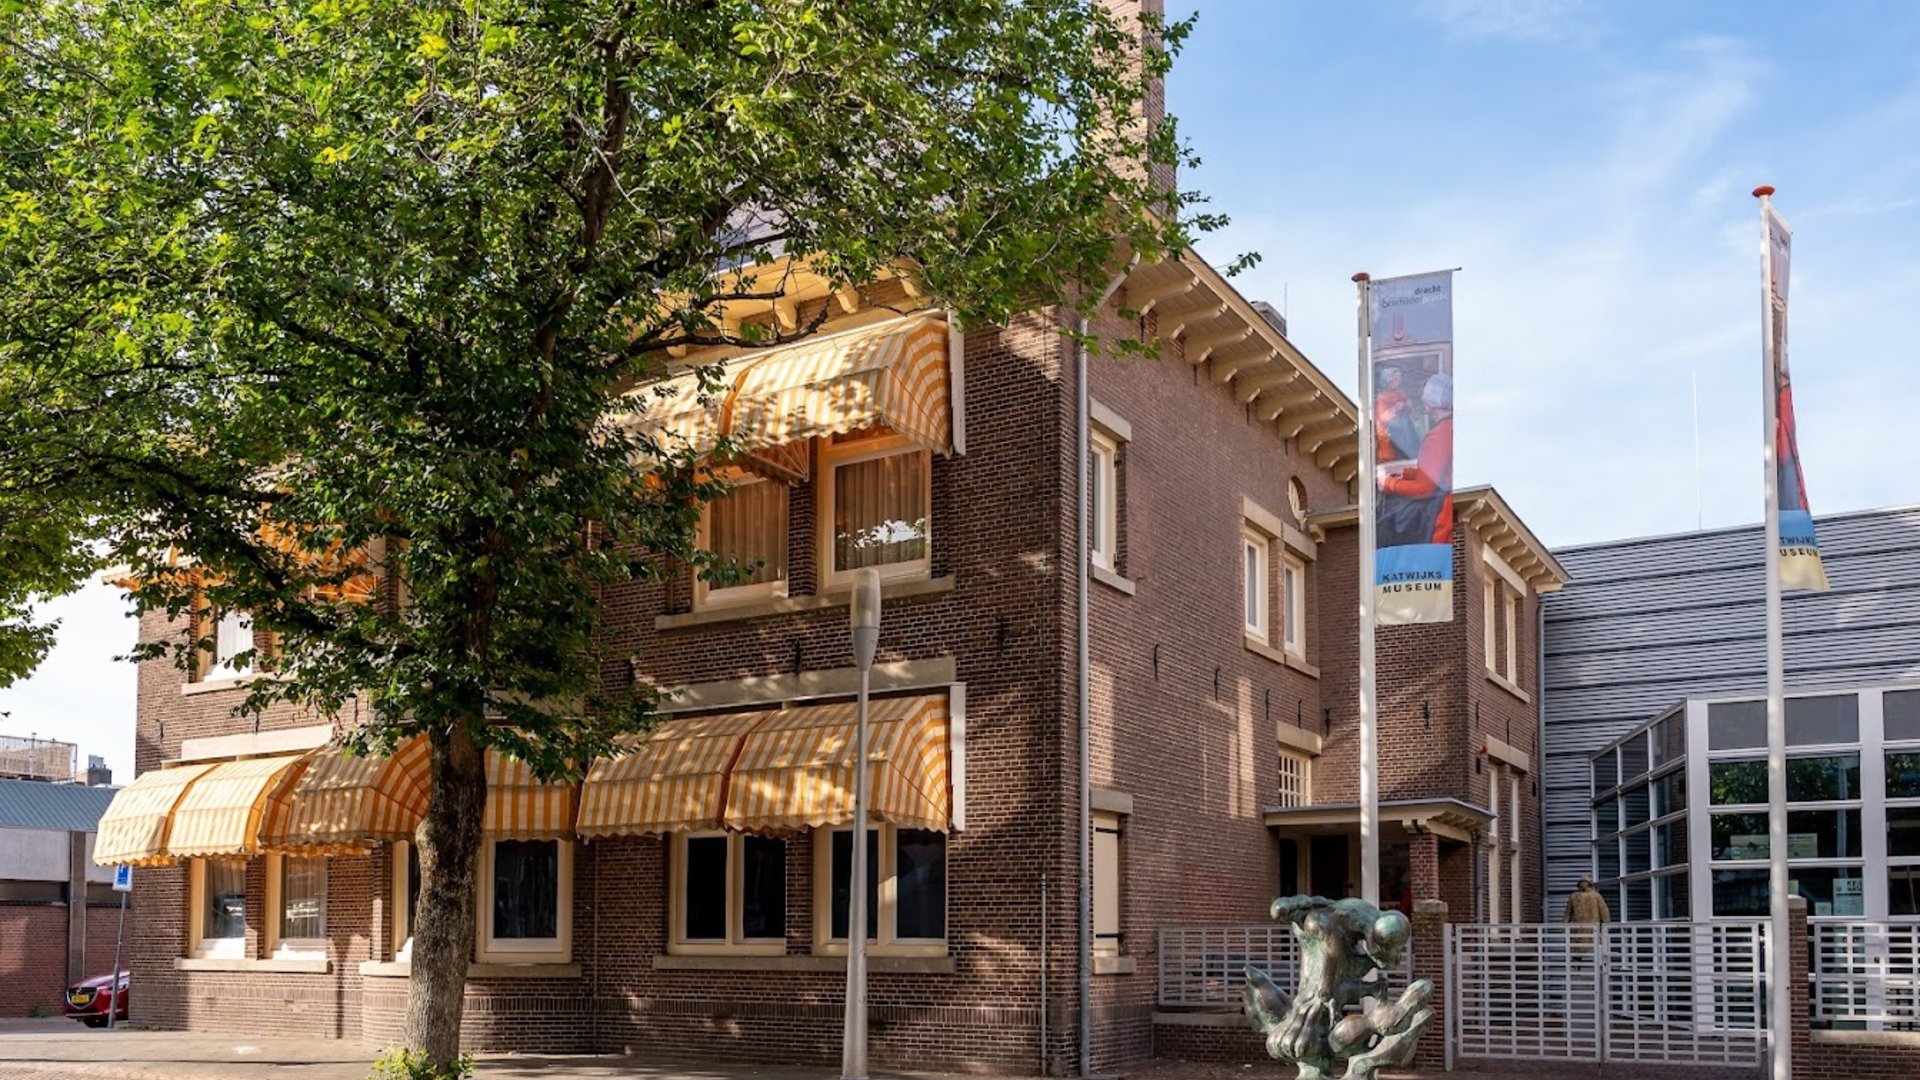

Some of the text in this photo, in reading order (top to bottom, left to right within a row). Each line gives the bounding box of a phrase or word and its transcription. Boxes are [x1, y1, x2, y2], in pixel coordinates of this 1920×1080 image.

[1779, 548, 1818, 557] USEUM
[1382, 570, 1442, 583] KATWIJKS
[1383, 582, 1442, 594] MUSEUM
